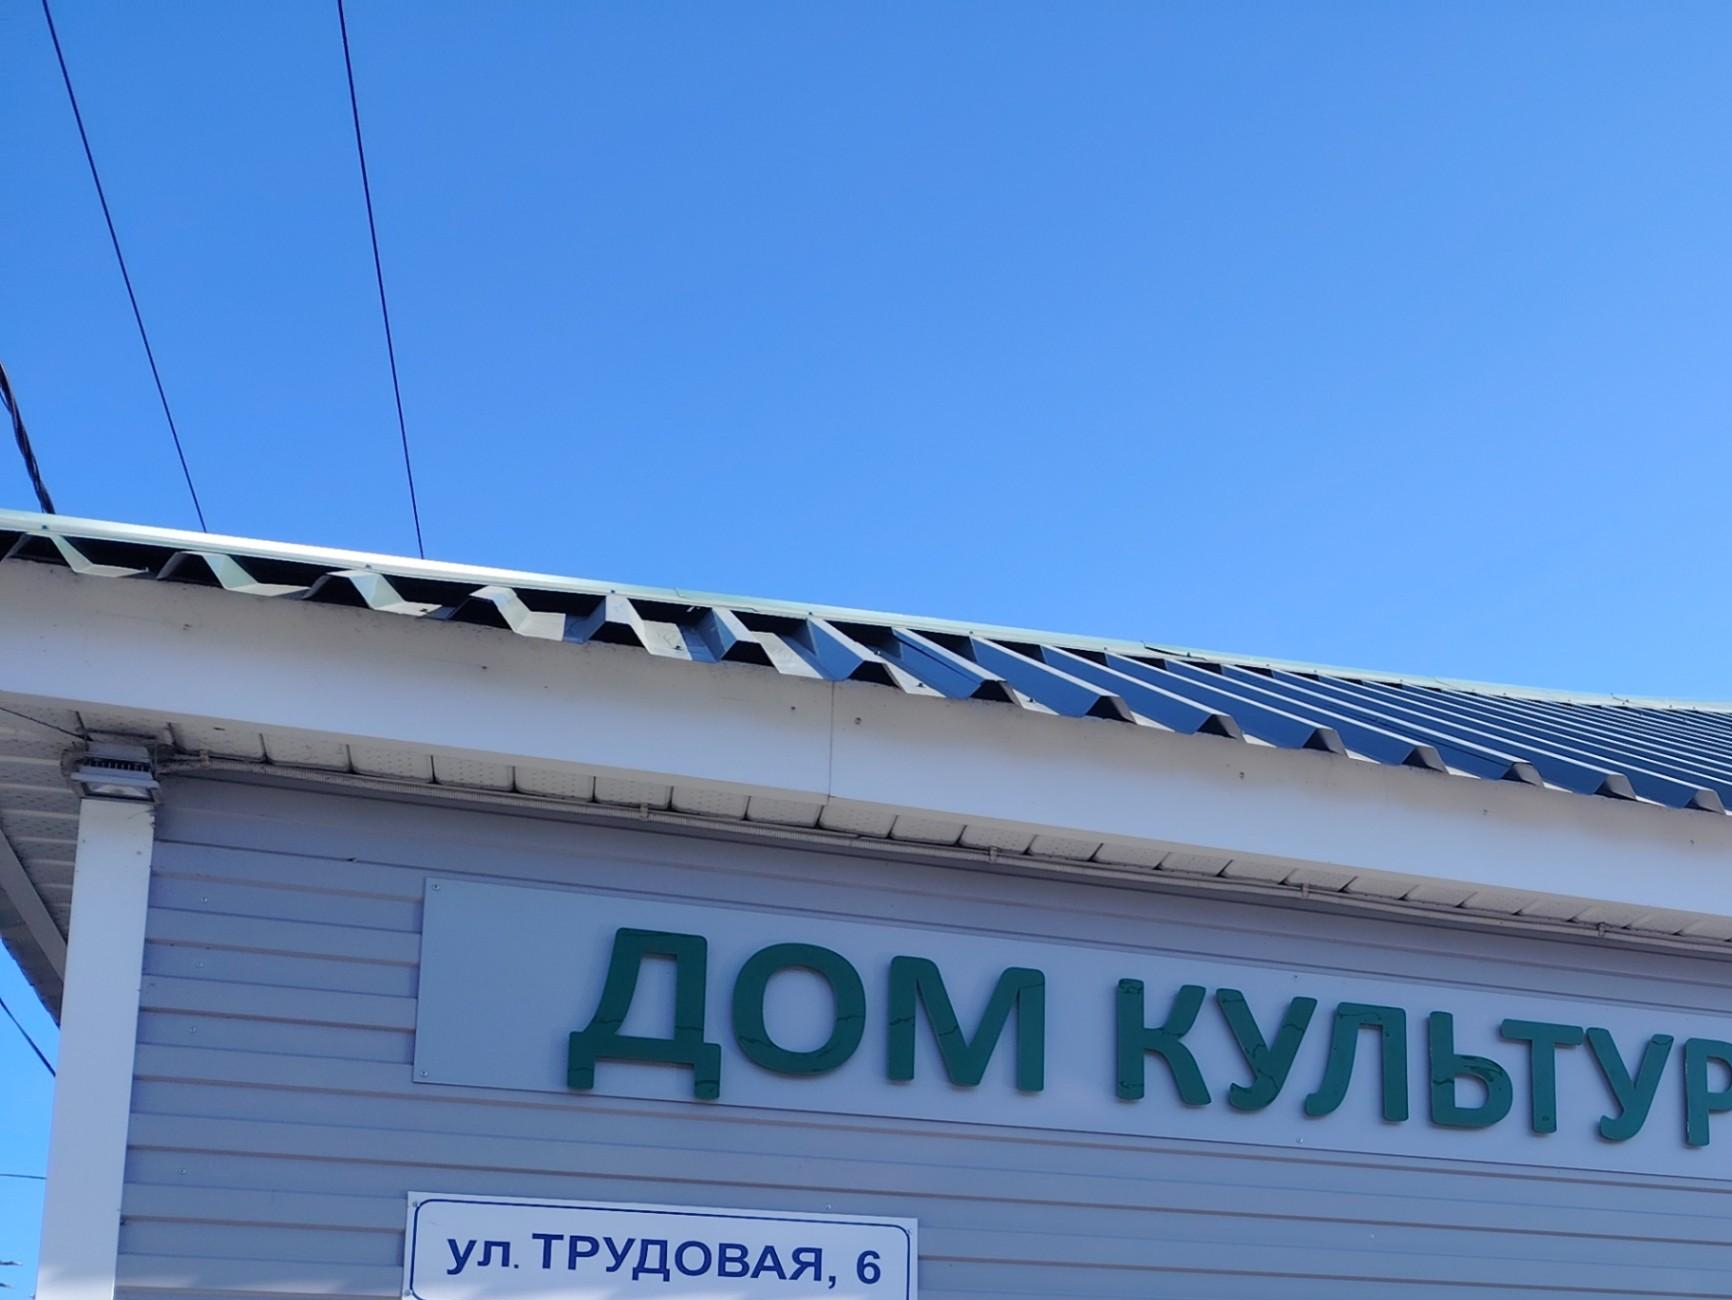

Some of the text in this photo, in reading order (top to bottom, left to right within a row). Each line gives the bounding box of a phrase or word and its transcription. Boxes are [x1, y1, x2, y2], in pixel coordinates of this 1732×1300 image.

[567, 926, 1046, 1101] ДОМ
[446, 1233, 882, 1289] ул. ТРУДОВАЯ, 6
